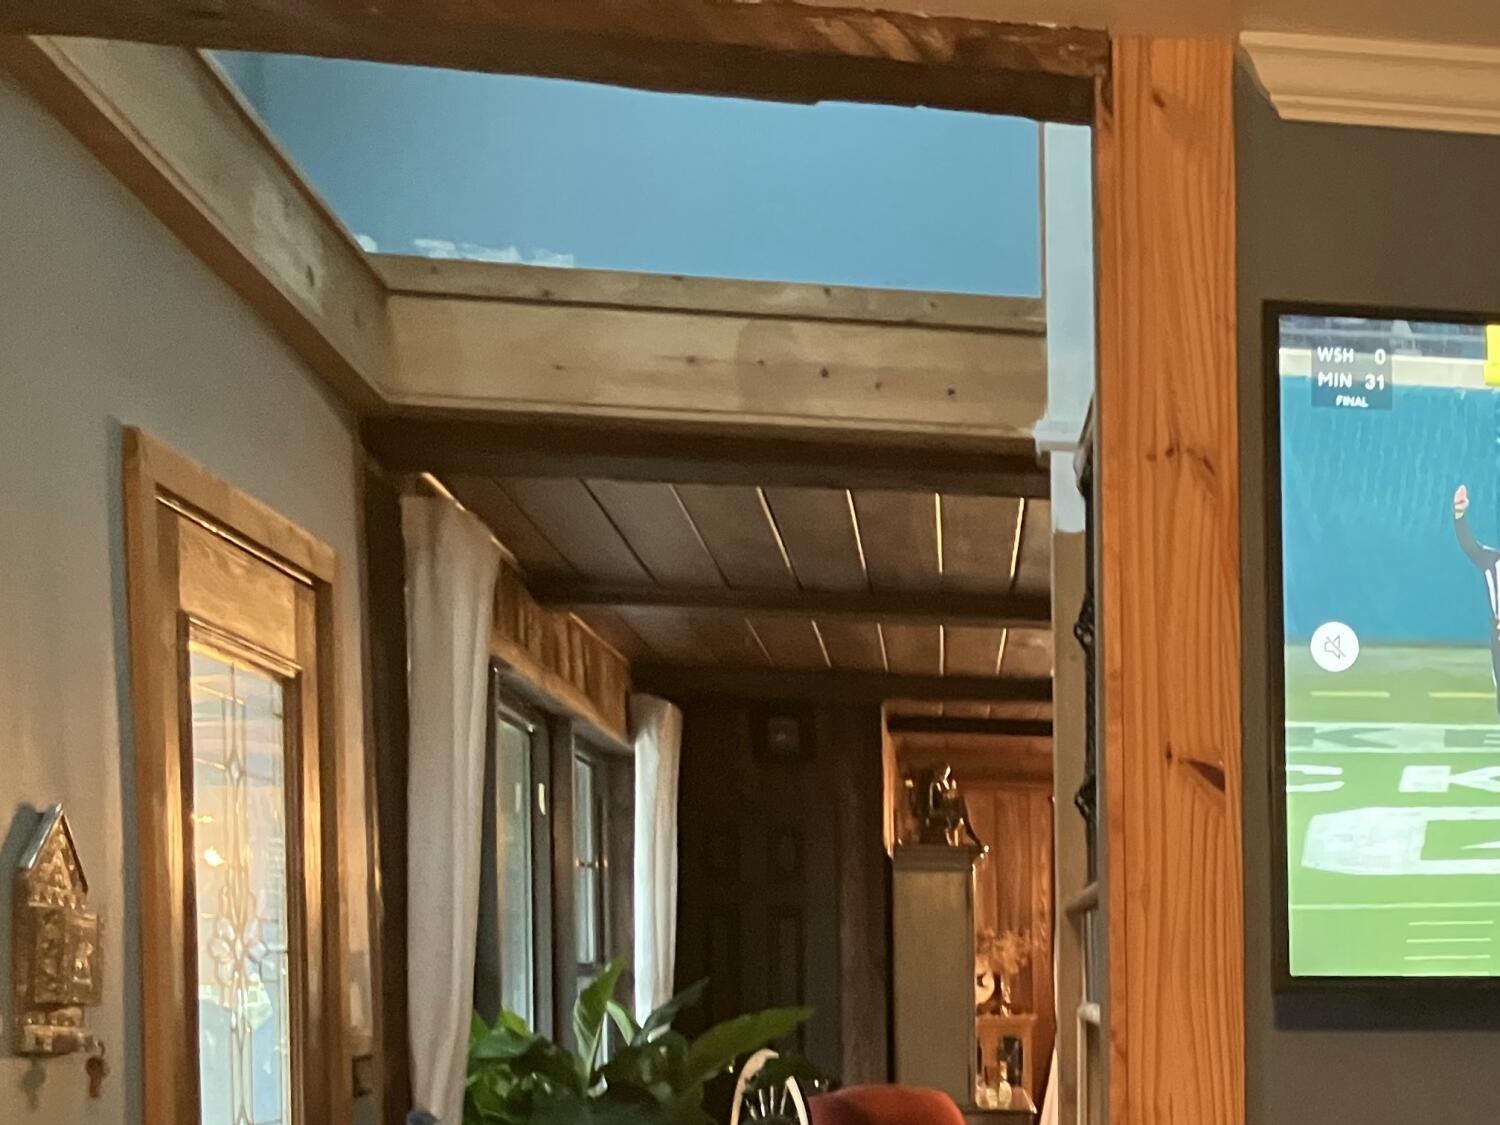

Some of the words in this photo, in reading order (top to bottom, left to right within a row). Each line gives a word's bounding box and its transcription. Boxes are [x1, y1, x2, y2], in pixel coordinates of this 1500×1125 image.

[1317, 346, 1354, 363] WSH
[1374, 348, 1386, 365] 0
[1318, 371, 1352, 388] MIN
[1365, 373, 1385, 390] 31
[1336, 394, 1369, 408] FINAL
